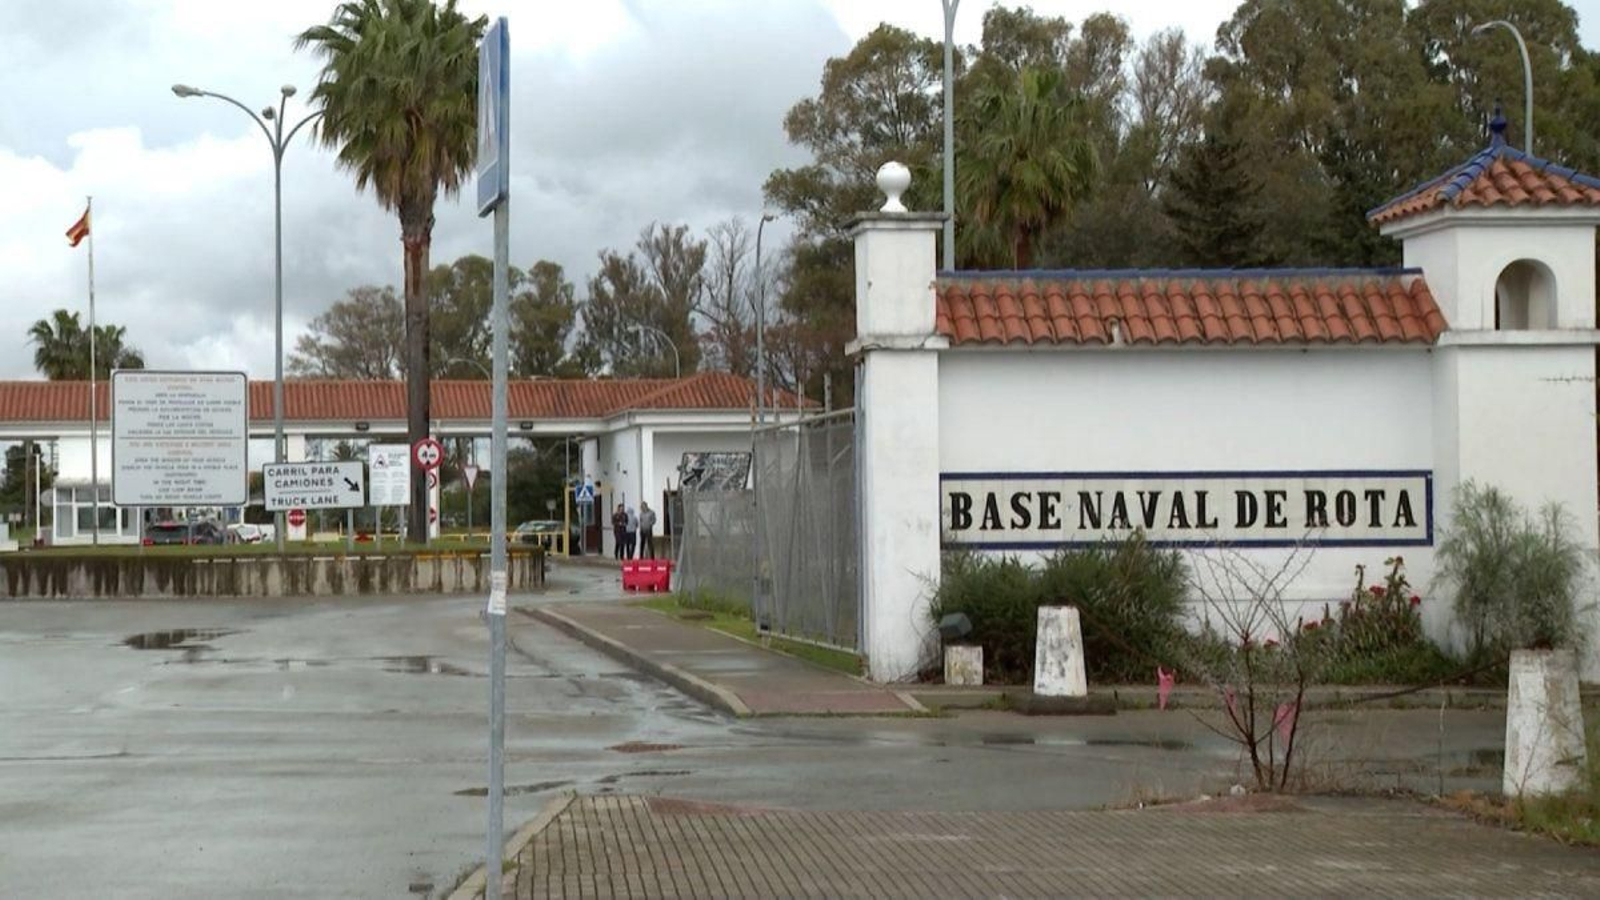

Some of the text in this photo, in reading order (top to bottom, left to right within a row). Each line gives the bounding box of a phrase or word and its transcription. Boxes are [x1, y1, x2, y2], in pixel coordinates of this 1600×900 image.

[267, 466, 340, 477] CARRIL PARA
[274, 478, 334, 488] CAMIONES
[271, 495, 339, 506] TRUCK LANE
[949, 489, 1418, 530] BASE NAVAL DE ROTA
